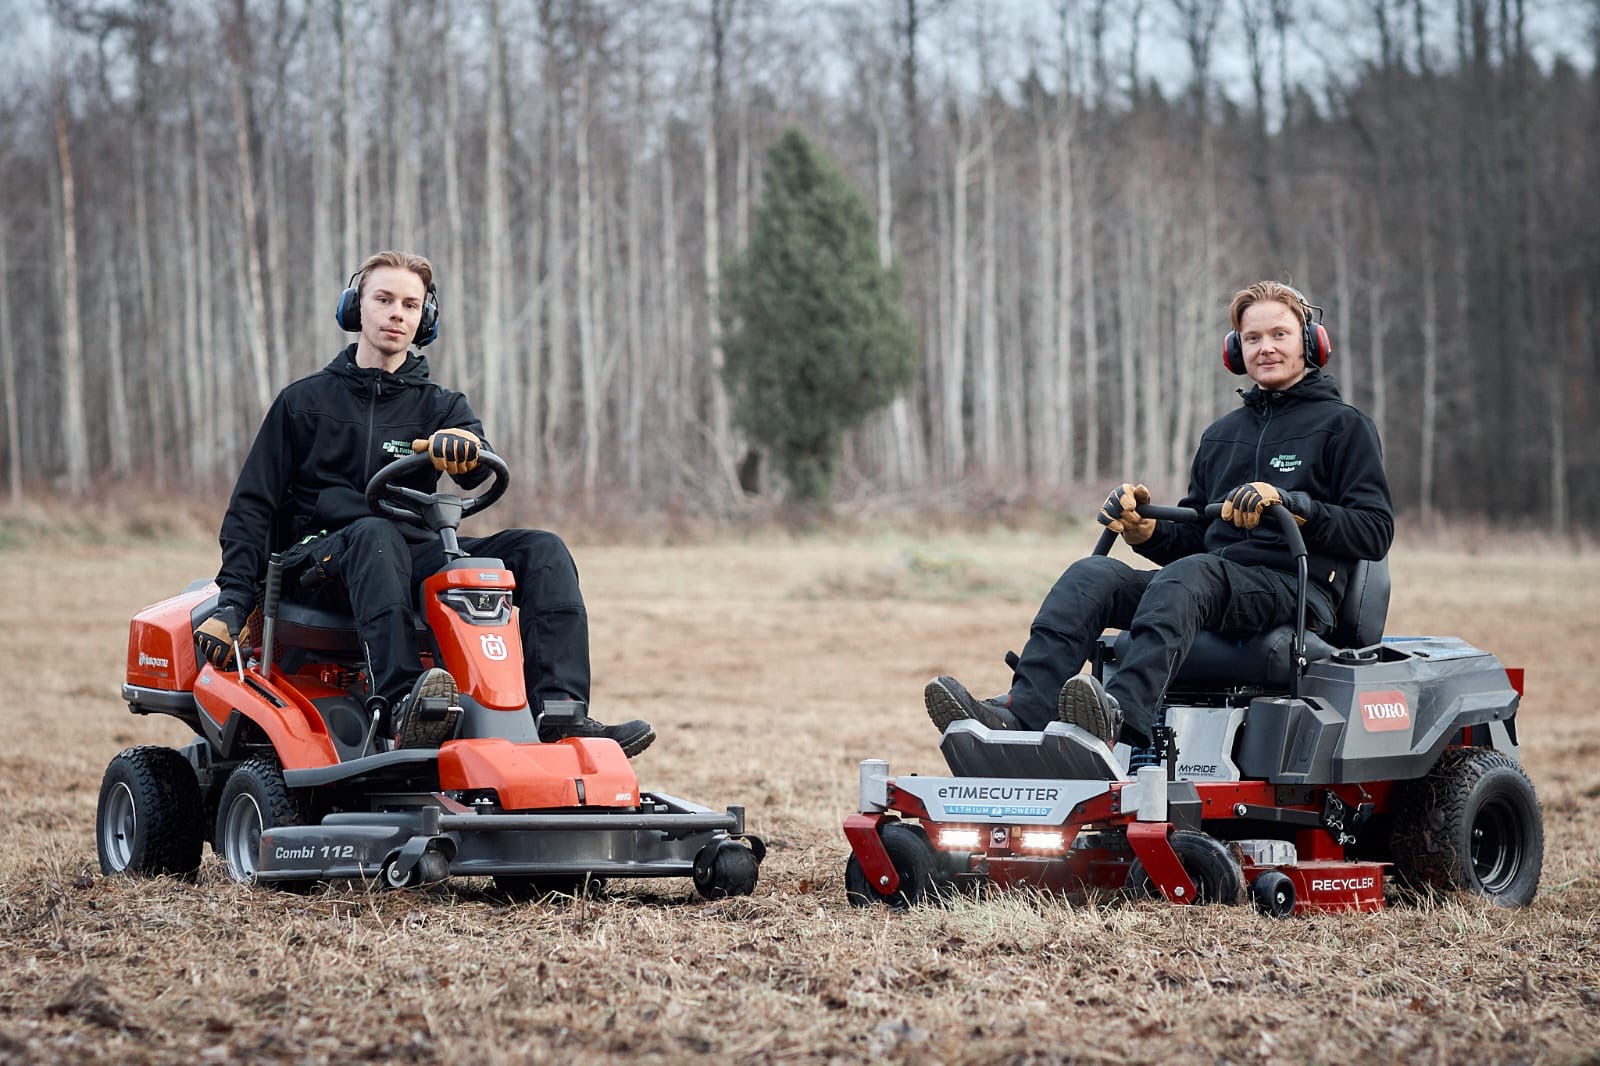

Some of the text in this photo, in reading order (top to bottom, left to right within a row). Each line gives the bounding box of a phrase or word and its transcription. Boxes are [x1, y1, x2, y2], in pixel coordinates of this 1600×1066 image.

[948, 806, 1047, 815] LITHIUM POWERED
[275, 845, 354, 859] Combi 112
[1312, 877, 1374, 891] RECYCLER
